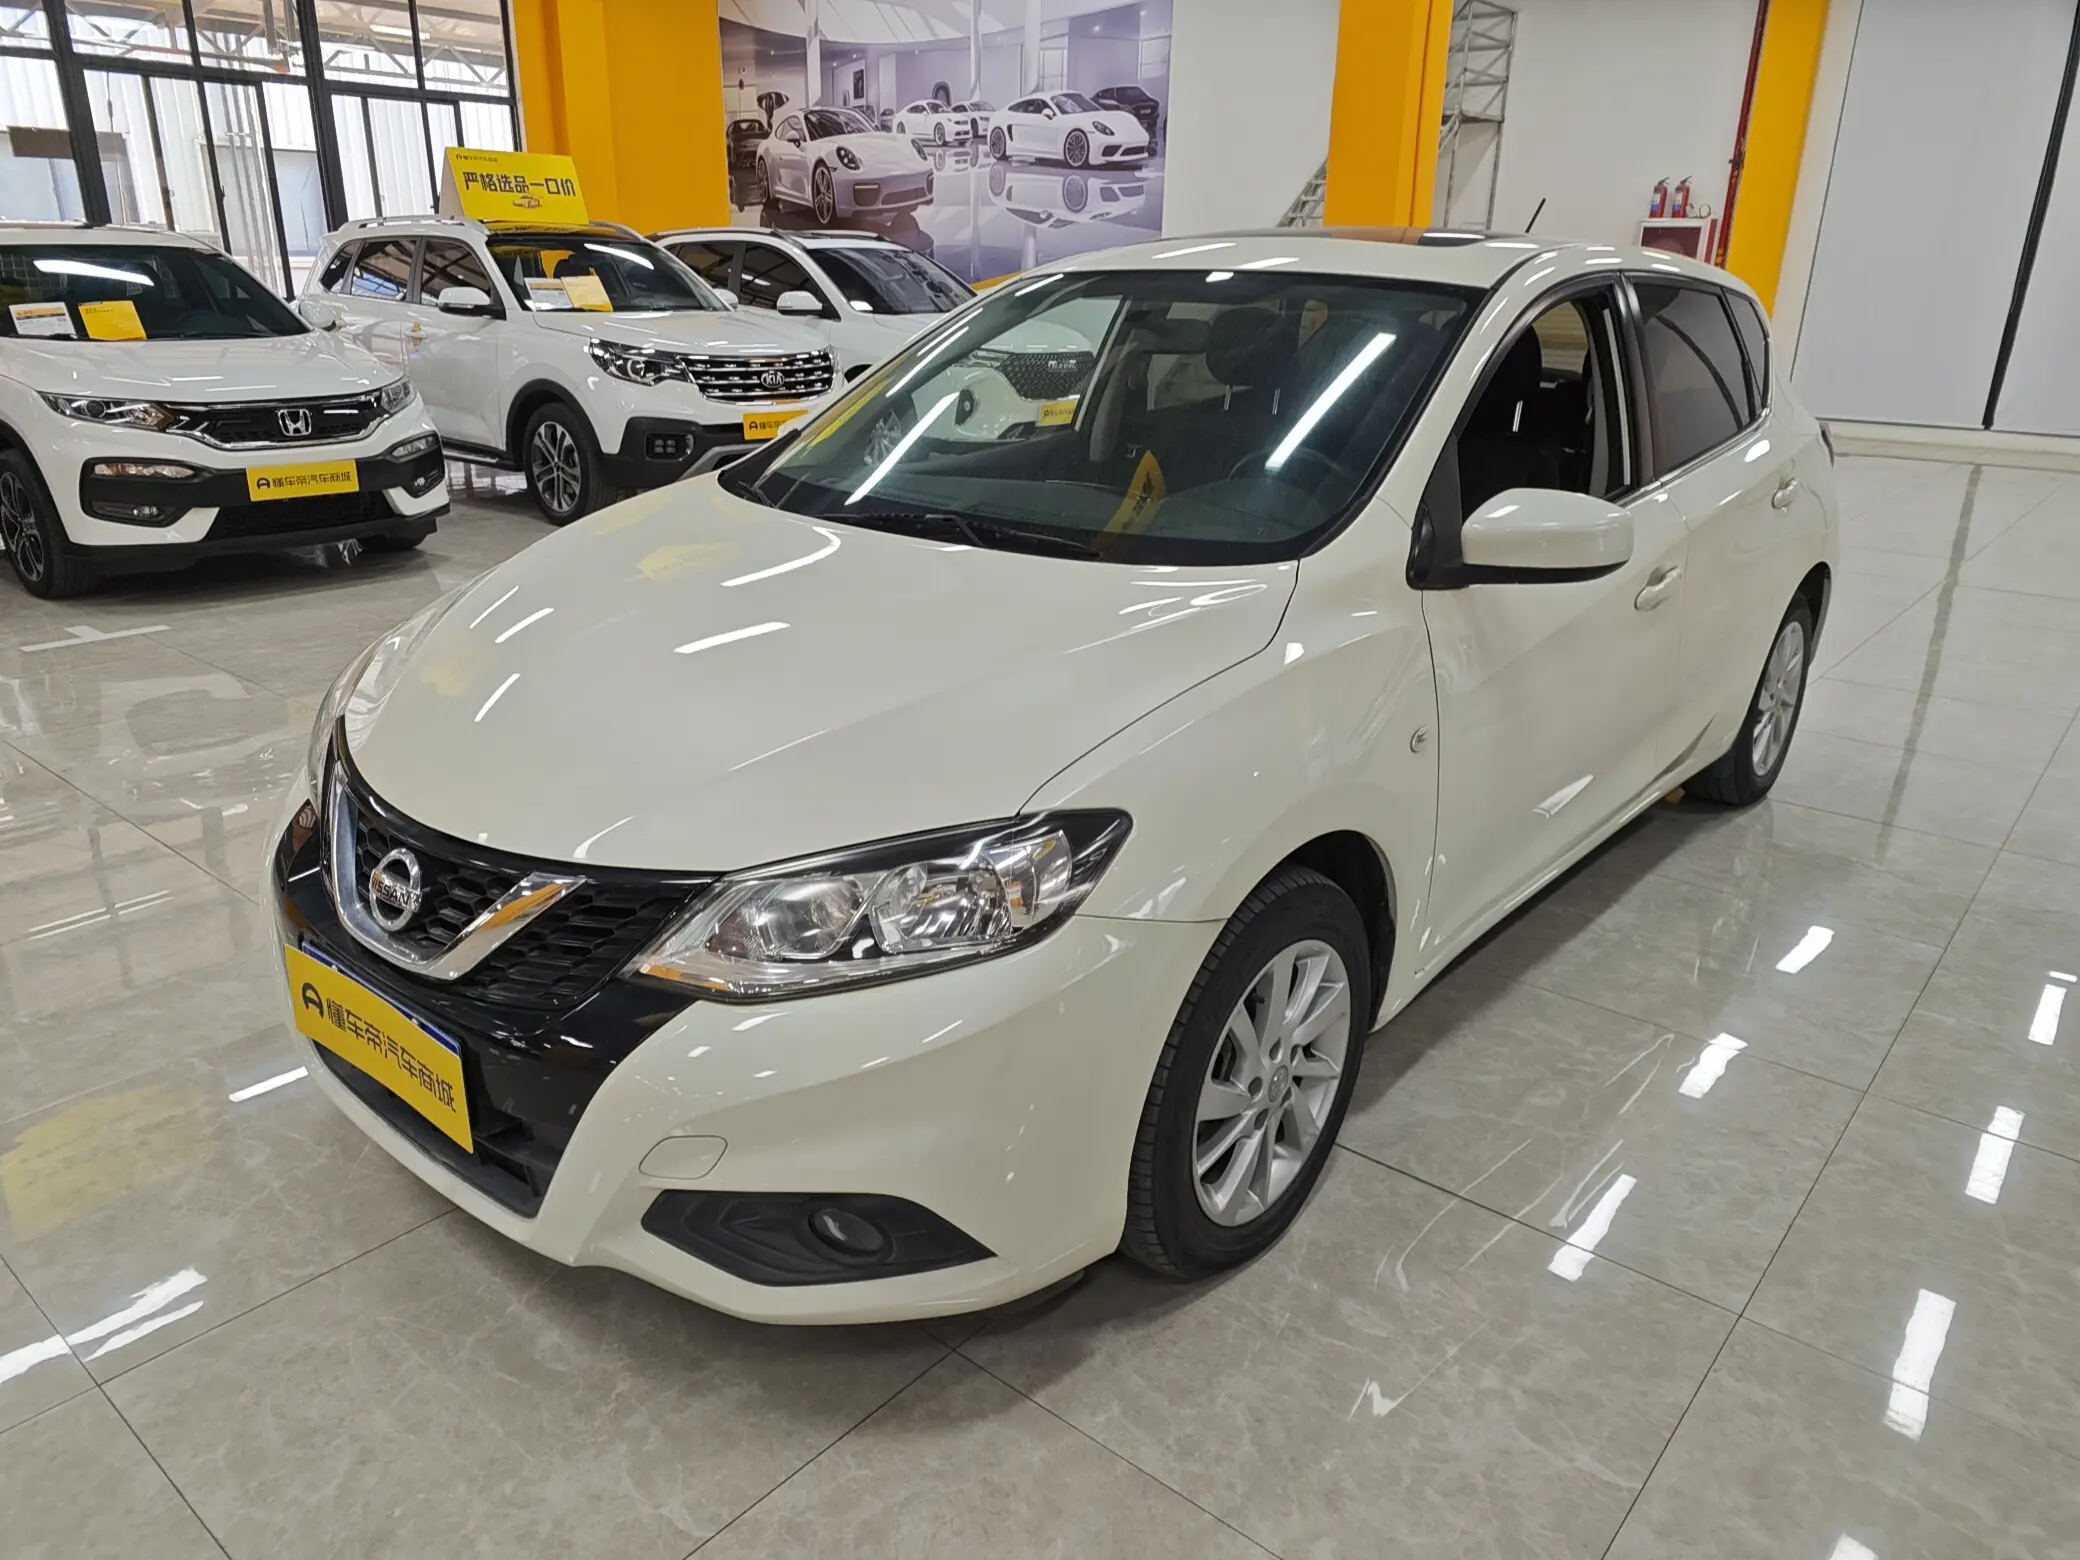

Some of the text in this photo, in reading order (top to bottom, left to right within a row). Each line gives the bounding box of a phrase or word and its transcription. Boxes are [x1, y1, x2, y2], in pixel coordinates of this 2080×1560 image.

[462, 171, 577, 196] 严格选品一口价
[272, 471, 352, 488] 懂车帝汽车商城
[325, 996, 458, 1114] 懂车帝汽车商城
